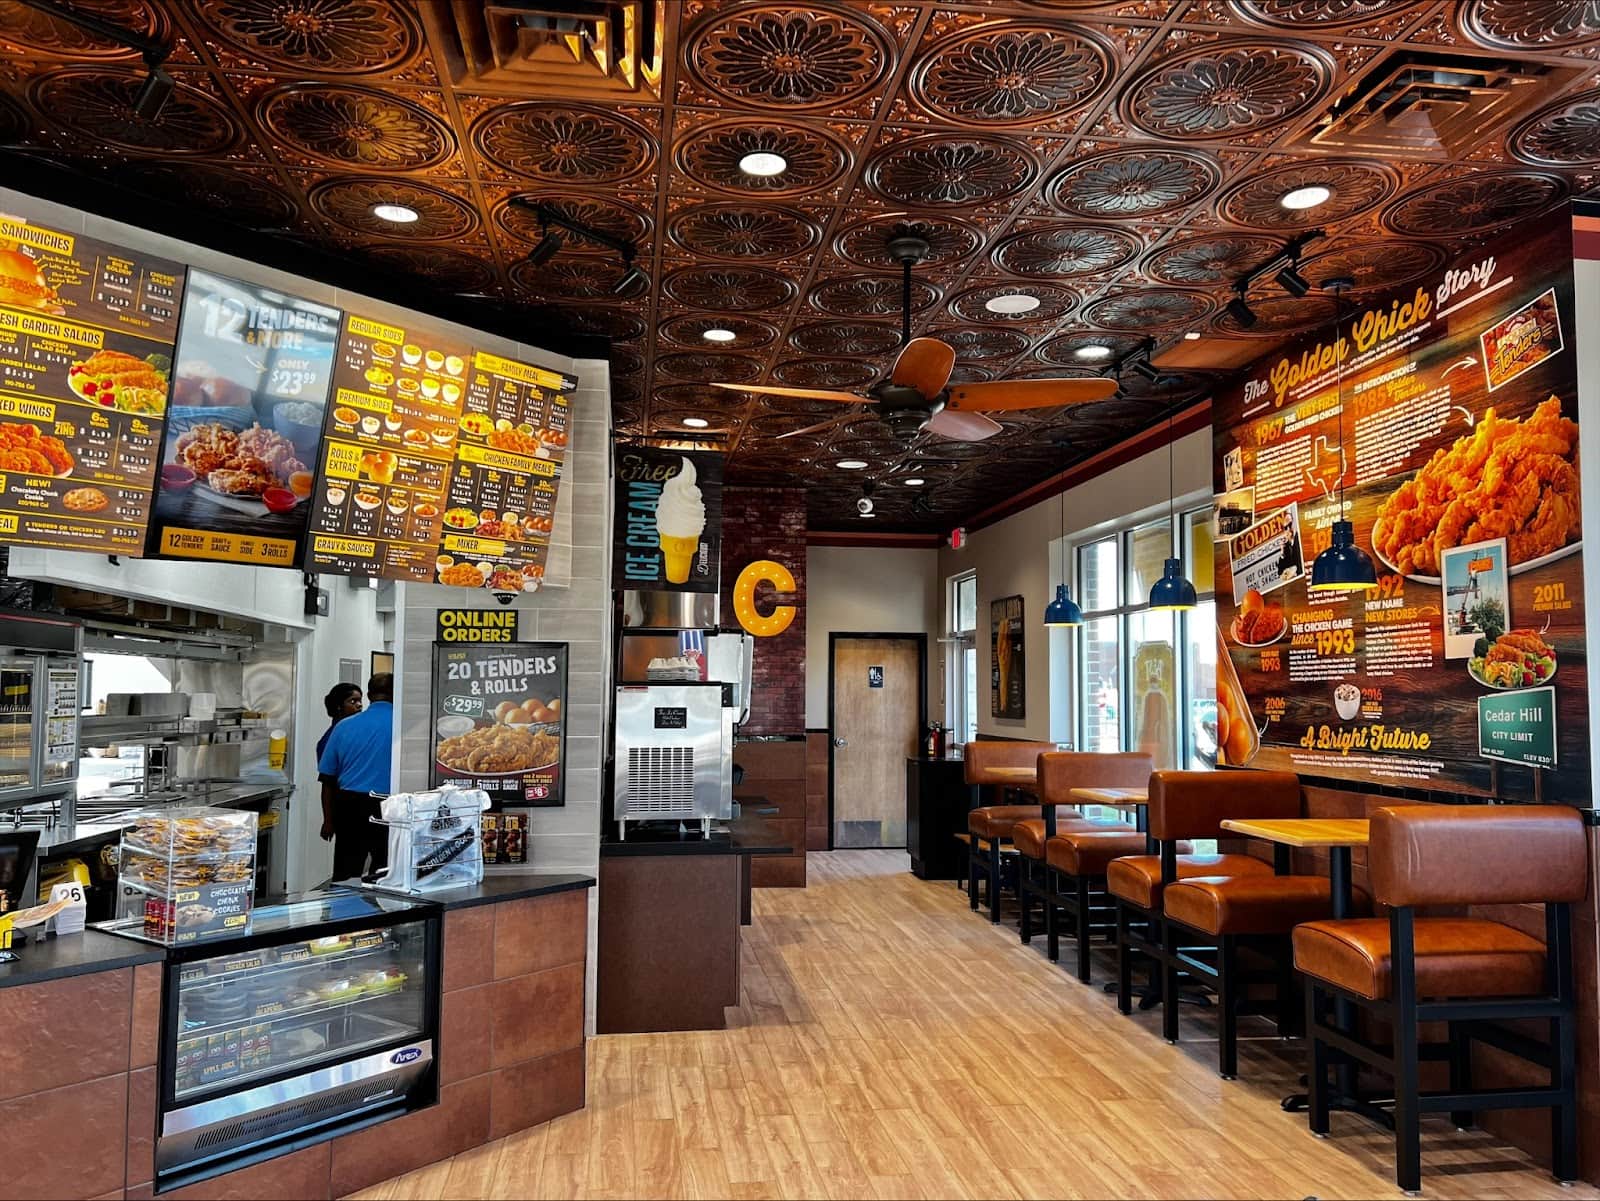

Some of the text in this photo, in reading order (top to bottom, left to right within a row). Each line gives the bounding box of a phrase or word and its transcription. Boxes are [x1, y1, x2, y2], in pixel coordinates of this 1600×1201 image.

[1, 222, 70, 251] SANDWICHES
[200, 294, 329, 344] 12 TENDERS
[0, 314, 100, 345] ESH GARDEN SALADS
[351, 319, 403, 342] REGULAR SIDES
[1244, 379, 1269, 404] The
[1270, 336, 1350, 407] Golden
[1352, 287, 1433, 353] Chick
[1436, 256, 1496, 311] Story
[247, 329, 305, 350] & MORE
[1495, 327, 1542, 375] Tenders
[278, 359, 310, 370] ONLY
[523, 367, 538, 381] MEAL
[1362, 366, 1409, 390] INTRODUCTION
[339, 392, 391, 411] PREMIUM SIDES
[1353, 384, 1387, 416] 1985
[19, 403, 52, 417] WINGS
[1256, 417, 1285, 445] 1967
[1317, 392, 1340, 412] FIRST
[54, 424, 75, 436] ZING
[331, 448, 353, 460] ROLLS
[329, 460, 358, 473] EXTRAS
[532, 462, 552, 474] MEALS
[620, 455, 677, 481] Free
[25, 479, 51, 488] NEW!
[1304, 507, 1326, 520] FAMILY
[0, 518, 13, 529] EAL
[625, 482, 663, 581] ICE CREAM
[1233, 511, 1287, 559] GOLDEN
[170, 534, 182, 547] 12
[211, 543, 231, 553] SAUCE
[317, 539, 340, 550] GRAVY
[347, 543, 373, 554] SAUCES
[240, 546, 254, 554] SIDE
[261, 543, 288, 558] 3 ROLLS
[1237, 536, 1287, 568] FRIED CHICKEN
[1246, 559, 1280, 584] HOT CHICKEN
[733, 560, 796, 637] C
[1533, 582, 1565, 603] 2011
[1365, 598, 1403, 611] NEW NAME
[440, 610, 515, 627] ONLINE
[1292, 609, 1334, 624] CHANGING
[1365, 606, 1418, 623] NEW STORES
[1292, 618, 1353, 634] THE CHICKEN GAME
[443, 627, 511, 642] ORDERS
[1291, 629, 1356, 656] since 1993
[448, 656, 557, 680] 20 TENDERS
[1261, 657, 1280, 672] 1993
[471, 677, 528, 695] & ROLLS
[1361, 688, 1382, 701] 2016
[1264, 697, 1286, 709] 2006
[1485, 707, 1542, 722] Cedar Hill
[1300, 724, 1432, 756] A Bright Future
[1491, 731, 1533, 742] CITY LIMIT
[210, 886, 246, 898] CHOCOLATE
[213, 905, 240, 915] COOKIES
